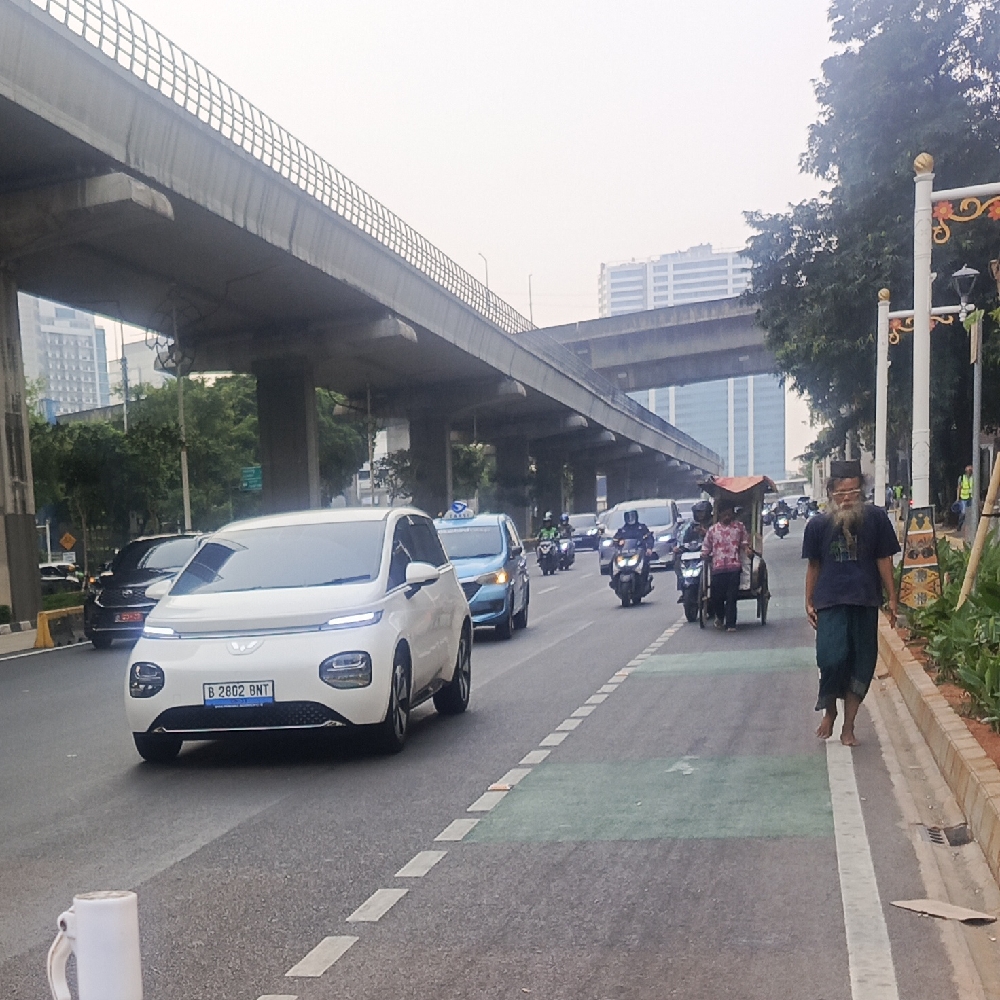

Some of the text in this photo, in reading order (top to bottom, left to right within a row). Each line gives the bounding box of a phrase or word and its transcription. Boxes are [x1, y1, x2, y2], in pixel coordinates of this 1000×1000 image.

[208, 684, 269, 698] B 2802 BNT
